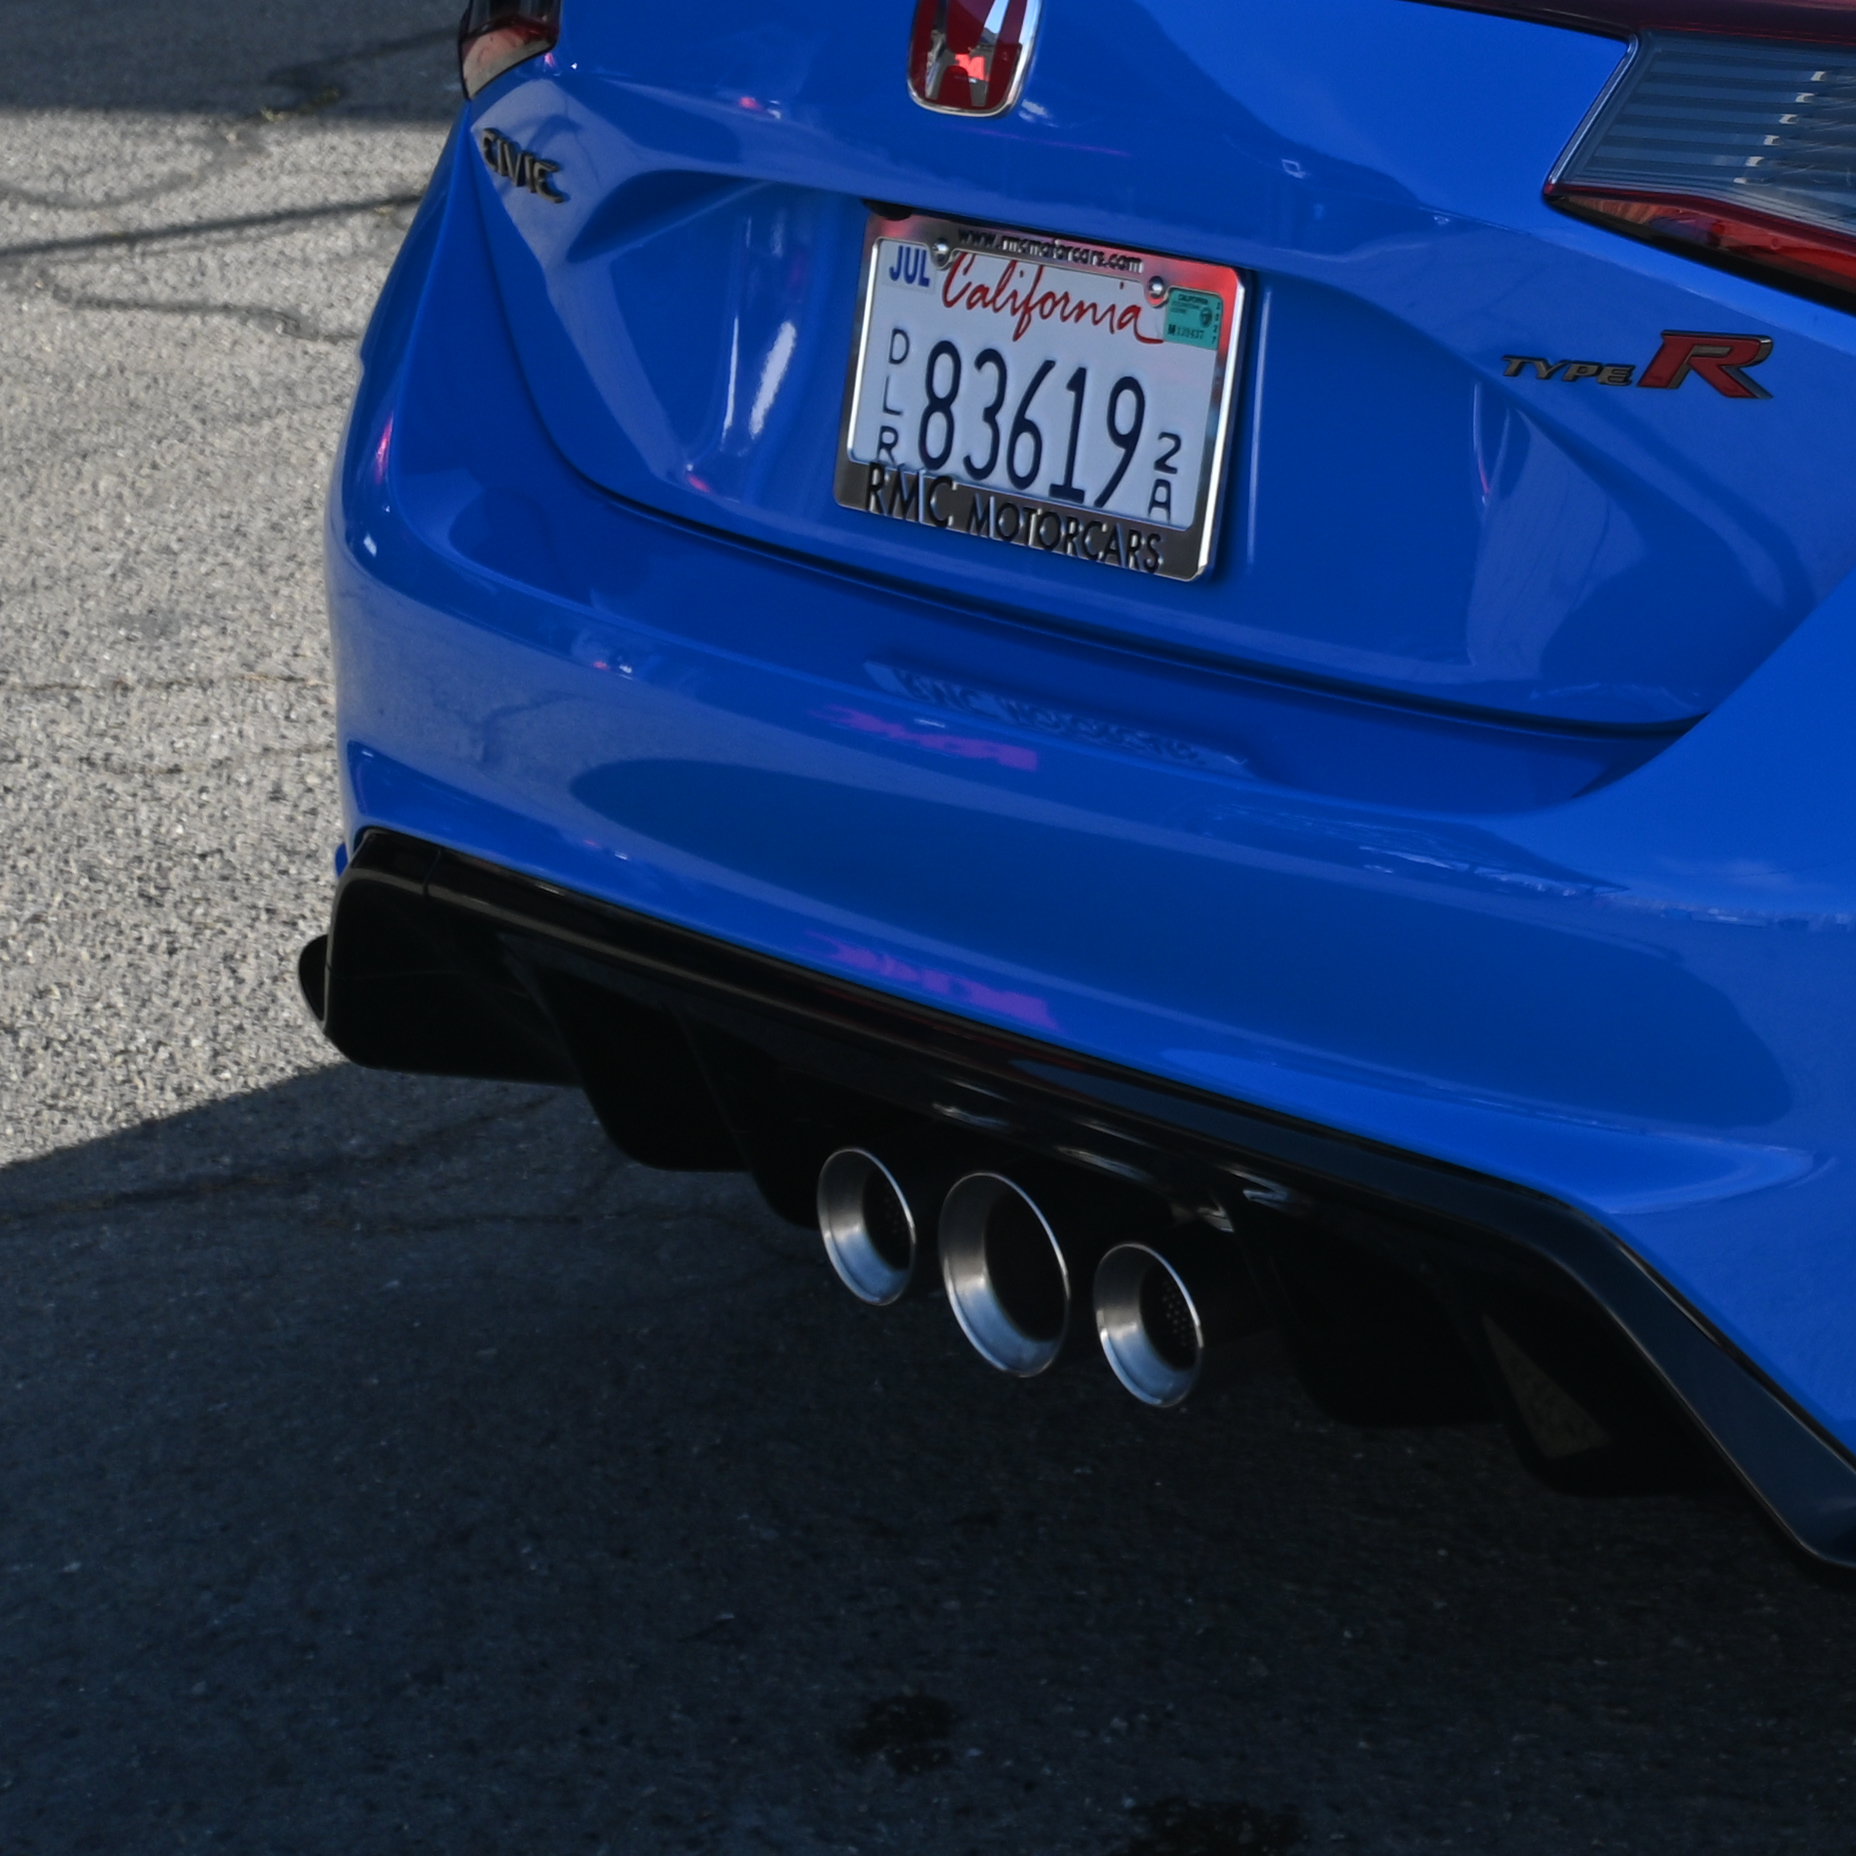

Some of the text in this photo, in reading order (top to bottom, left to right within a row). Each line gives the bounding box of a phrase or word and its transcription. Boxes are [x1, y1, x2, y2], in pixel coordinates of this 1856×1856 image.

[483, 128, 568, 204] CIVIC
[888, 246, 931, 288] JUL
[957, 227, 1144, 274] www.rmcmotorcars.com
[942, 250, 1164, 344] California
[1501, 329, 1774, 399] TYPE R
[918, 340, 1146, 509] 83619
[864, 461, 955, 529] RMC
[964, 493, 1164, 574] MOTORCARS
